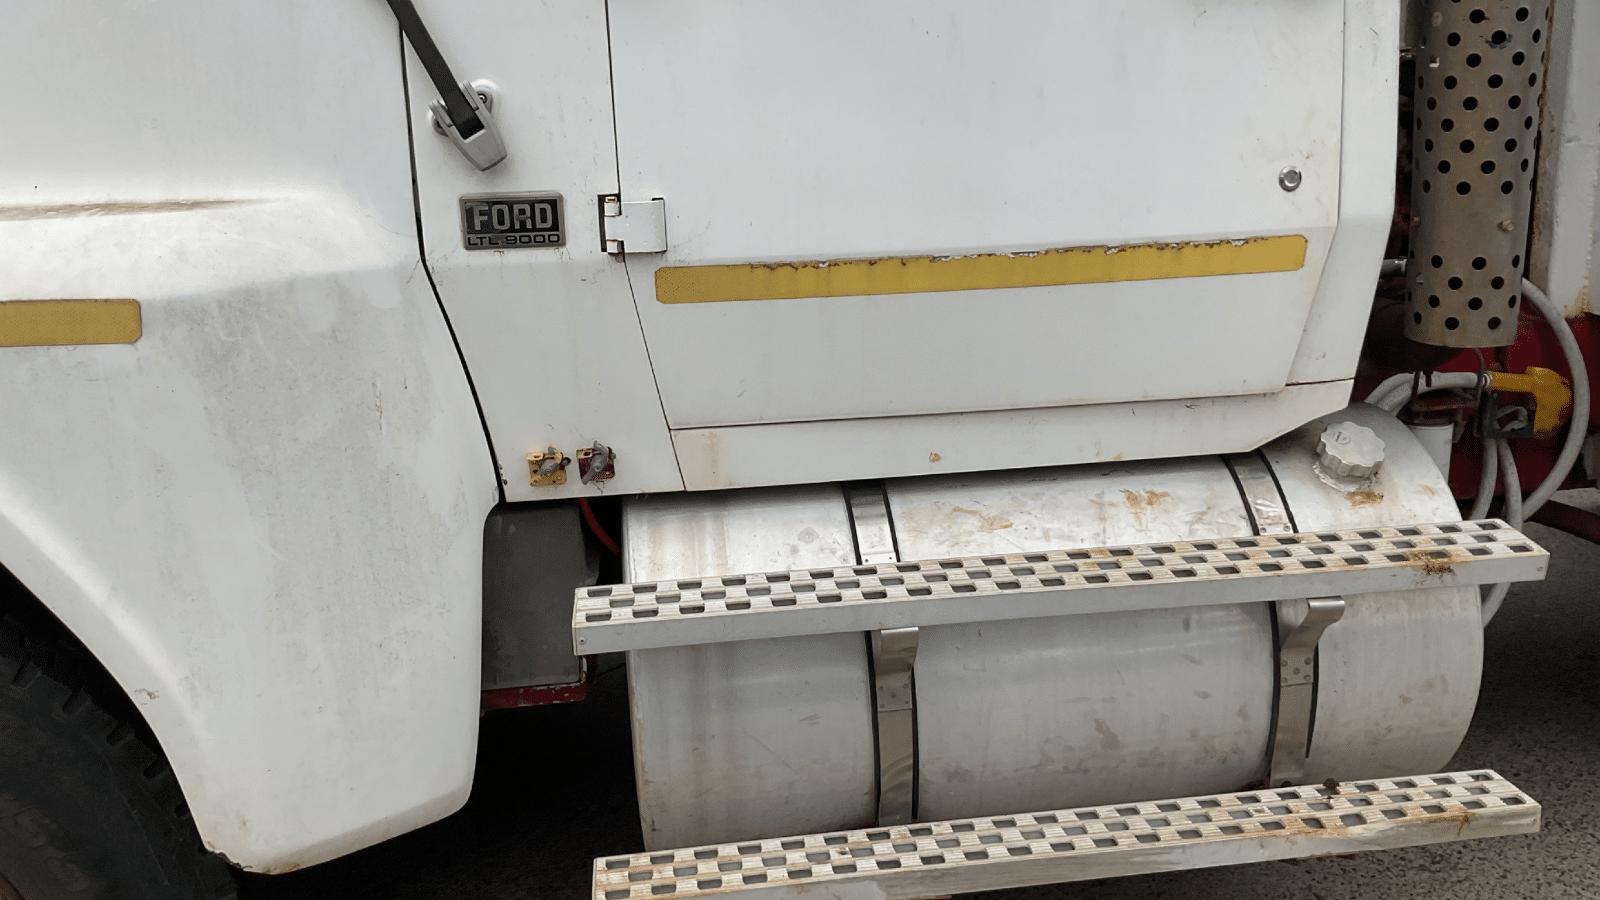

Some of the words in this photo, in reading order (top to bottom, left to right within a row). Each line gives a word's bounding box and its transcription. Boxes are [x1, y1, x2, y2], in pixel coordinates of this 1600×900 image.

[473, 203, 552, 230] FORD
[467, 236, 499, 246] LTL
[505, 234, 560, 244] 9000
